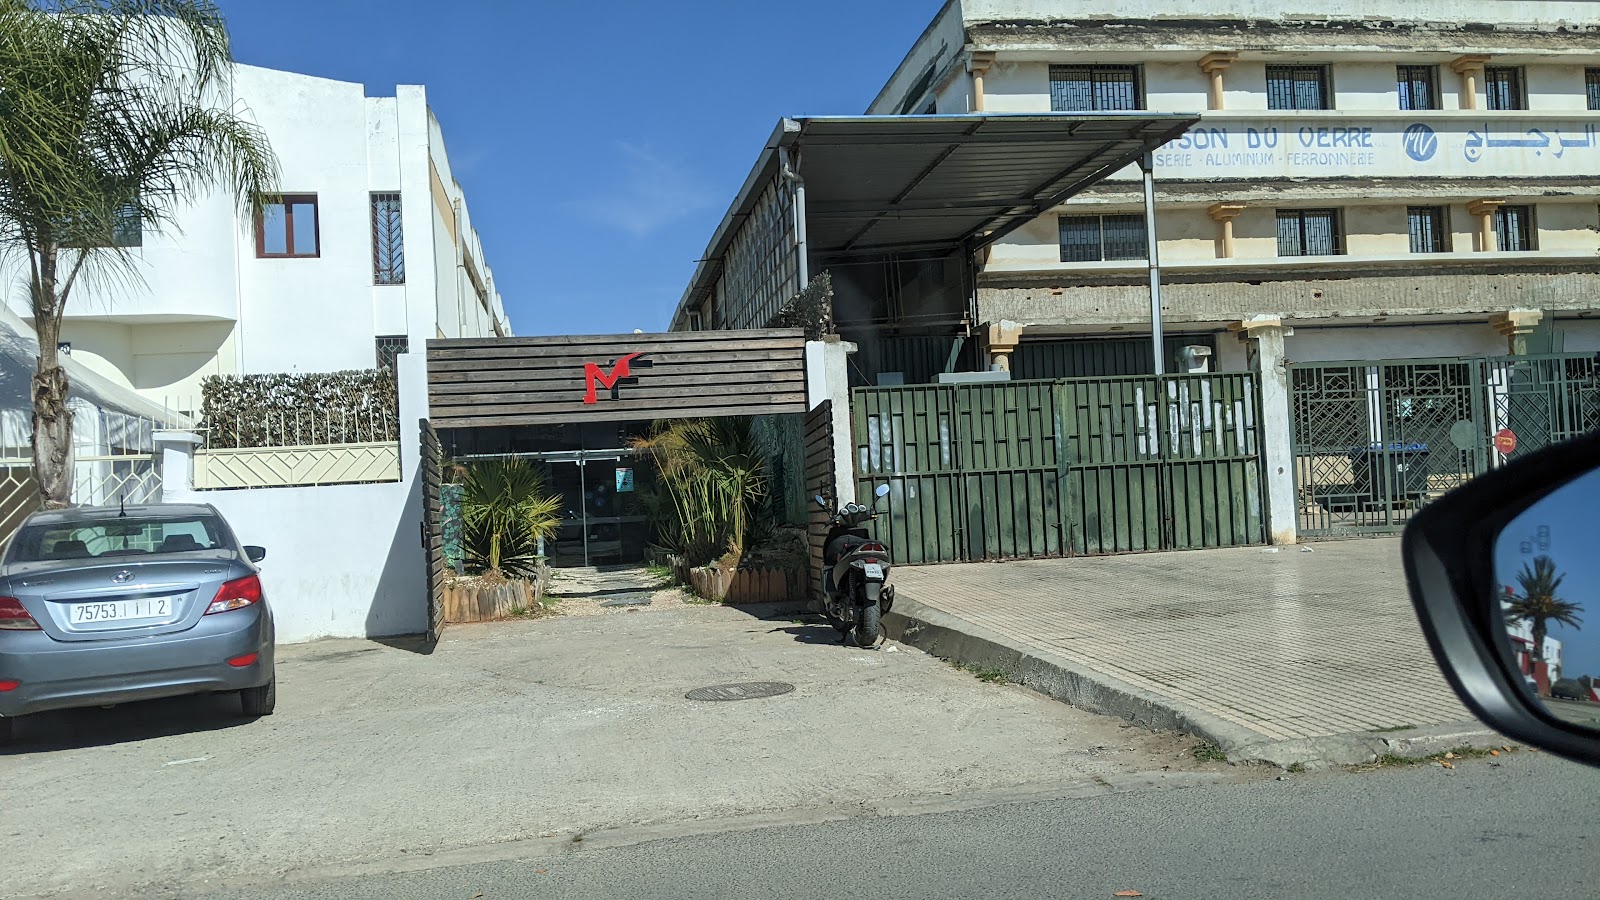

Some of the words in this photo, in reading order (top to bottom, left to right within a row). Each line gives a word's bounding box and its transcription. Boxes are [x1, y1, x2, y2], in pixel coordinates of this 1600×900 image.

[1247, 127, 1277, 149] DU
[1298, 127, 1373, 148] VERRE
[1155, 153, 1193, 167] SERIE
[1206, 152, 1274, 166] ALUMINUM
[1287, 152, 1374, 166] FERRONNERIE
[77, 603, 117, 621] 75753
